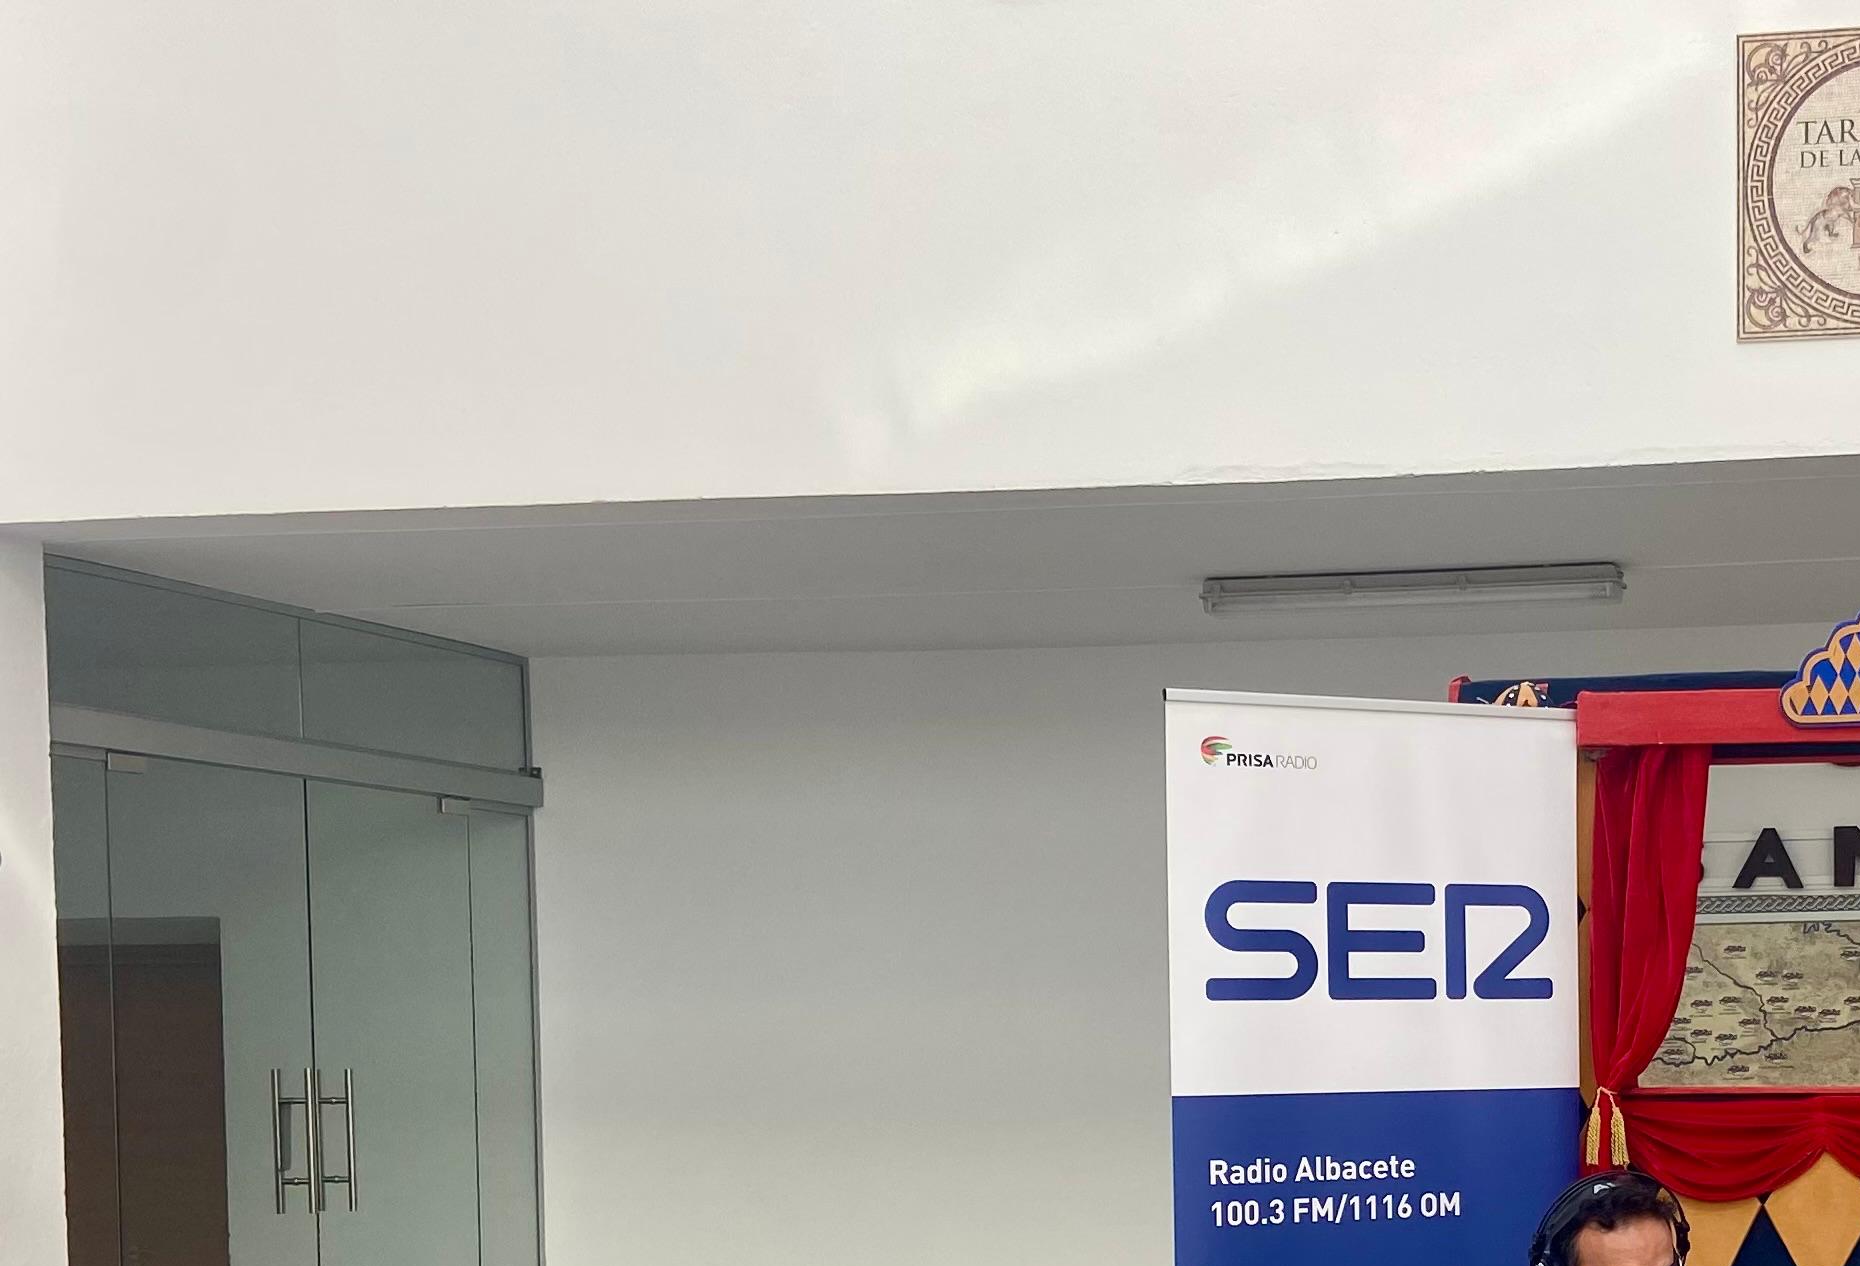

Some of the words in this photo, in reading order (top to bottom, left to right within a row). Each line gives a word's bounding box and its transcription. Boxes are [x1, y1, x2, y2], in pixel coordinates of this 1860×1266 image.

[1801, 151, 1830, 168] DE
[1226, 752, 1274, 768] PRISA
[1275, 755, 1317, 770] RADIO
[1204, 879, 1553, 1001] SER
[1209, 1158, 1287, 1185] Radio
[1295, 1155, 1416, 1183] Albacete
[1211, 1199, 1285, 1227] 100.3
[1293, 1193, 1413, 1224] FM/1116
[1420, 1192, 1461, 1217] OM
